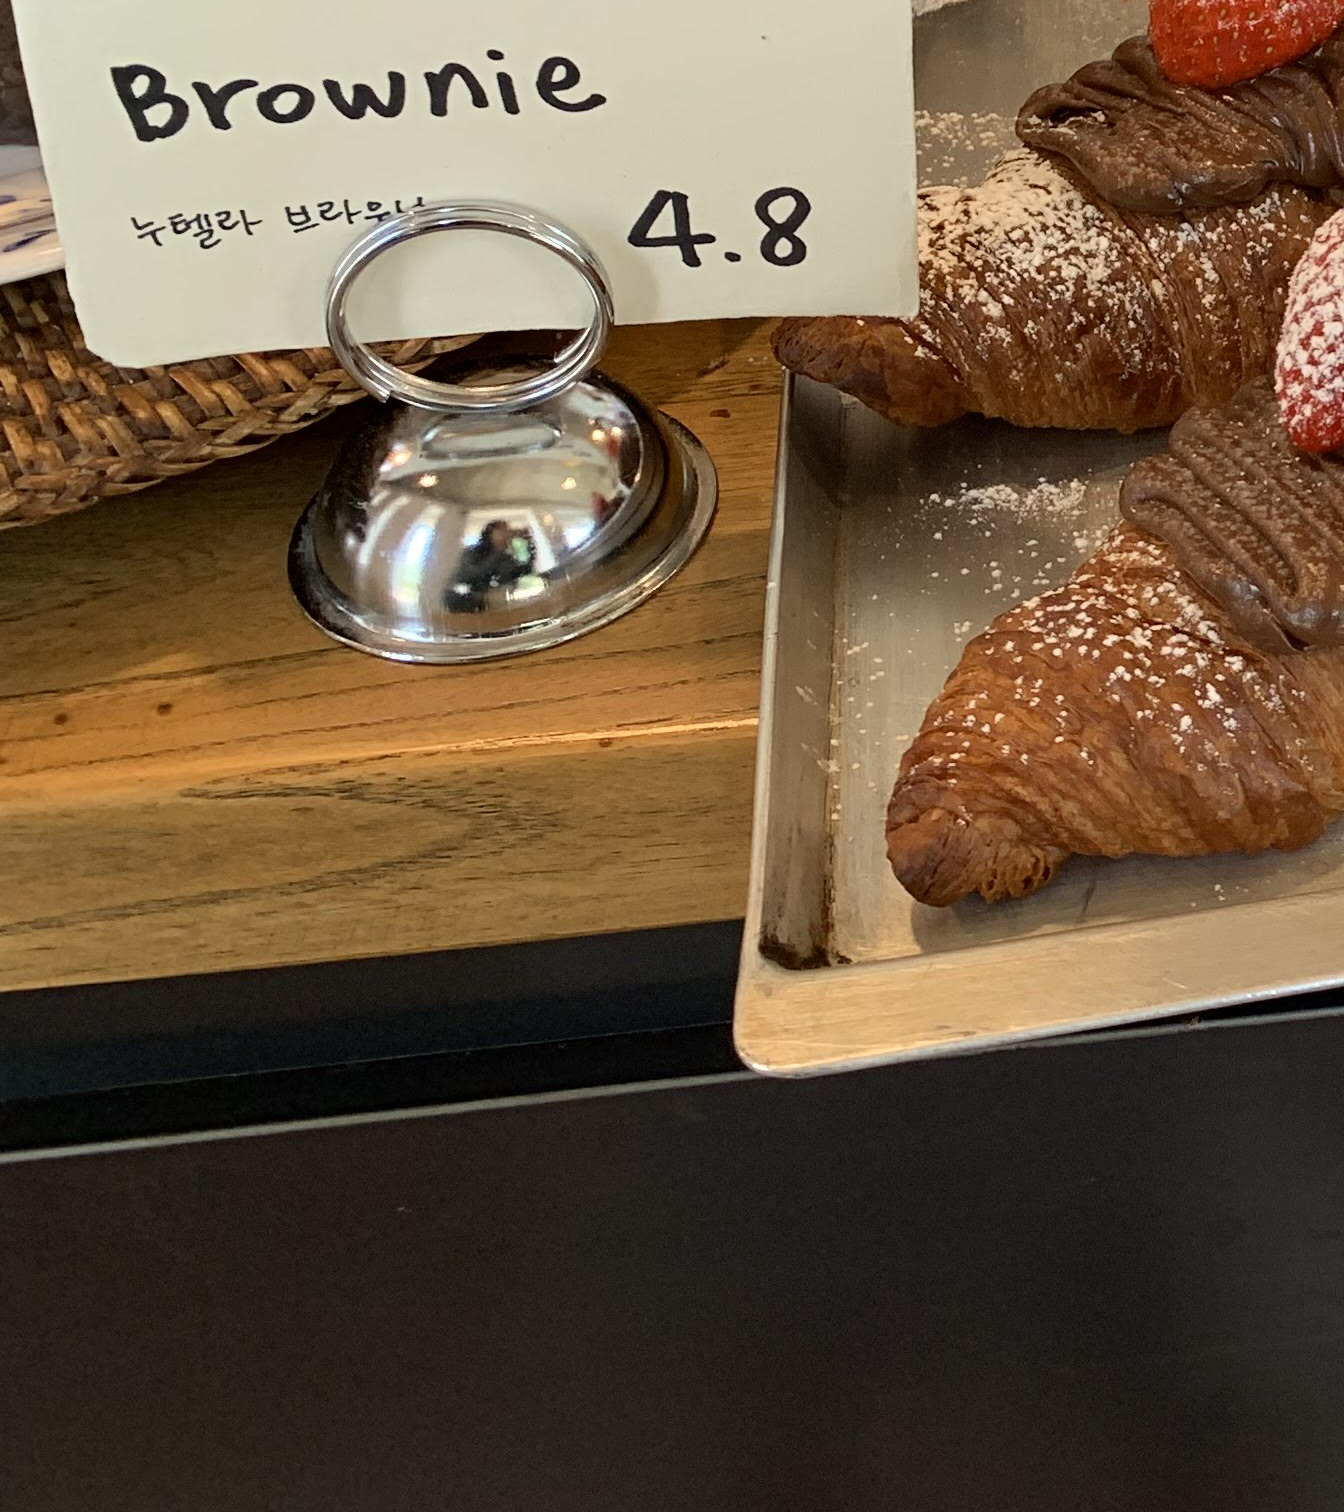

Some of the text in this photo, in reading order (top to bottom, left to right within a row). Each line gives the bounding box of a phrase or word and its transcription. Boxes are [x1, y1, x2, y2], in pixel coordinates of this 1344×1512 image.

[109, 48, 608, 143] Brownie
[129, 208, 264, 250] 누텔라
[626, 186, 813, 268] 4.8
